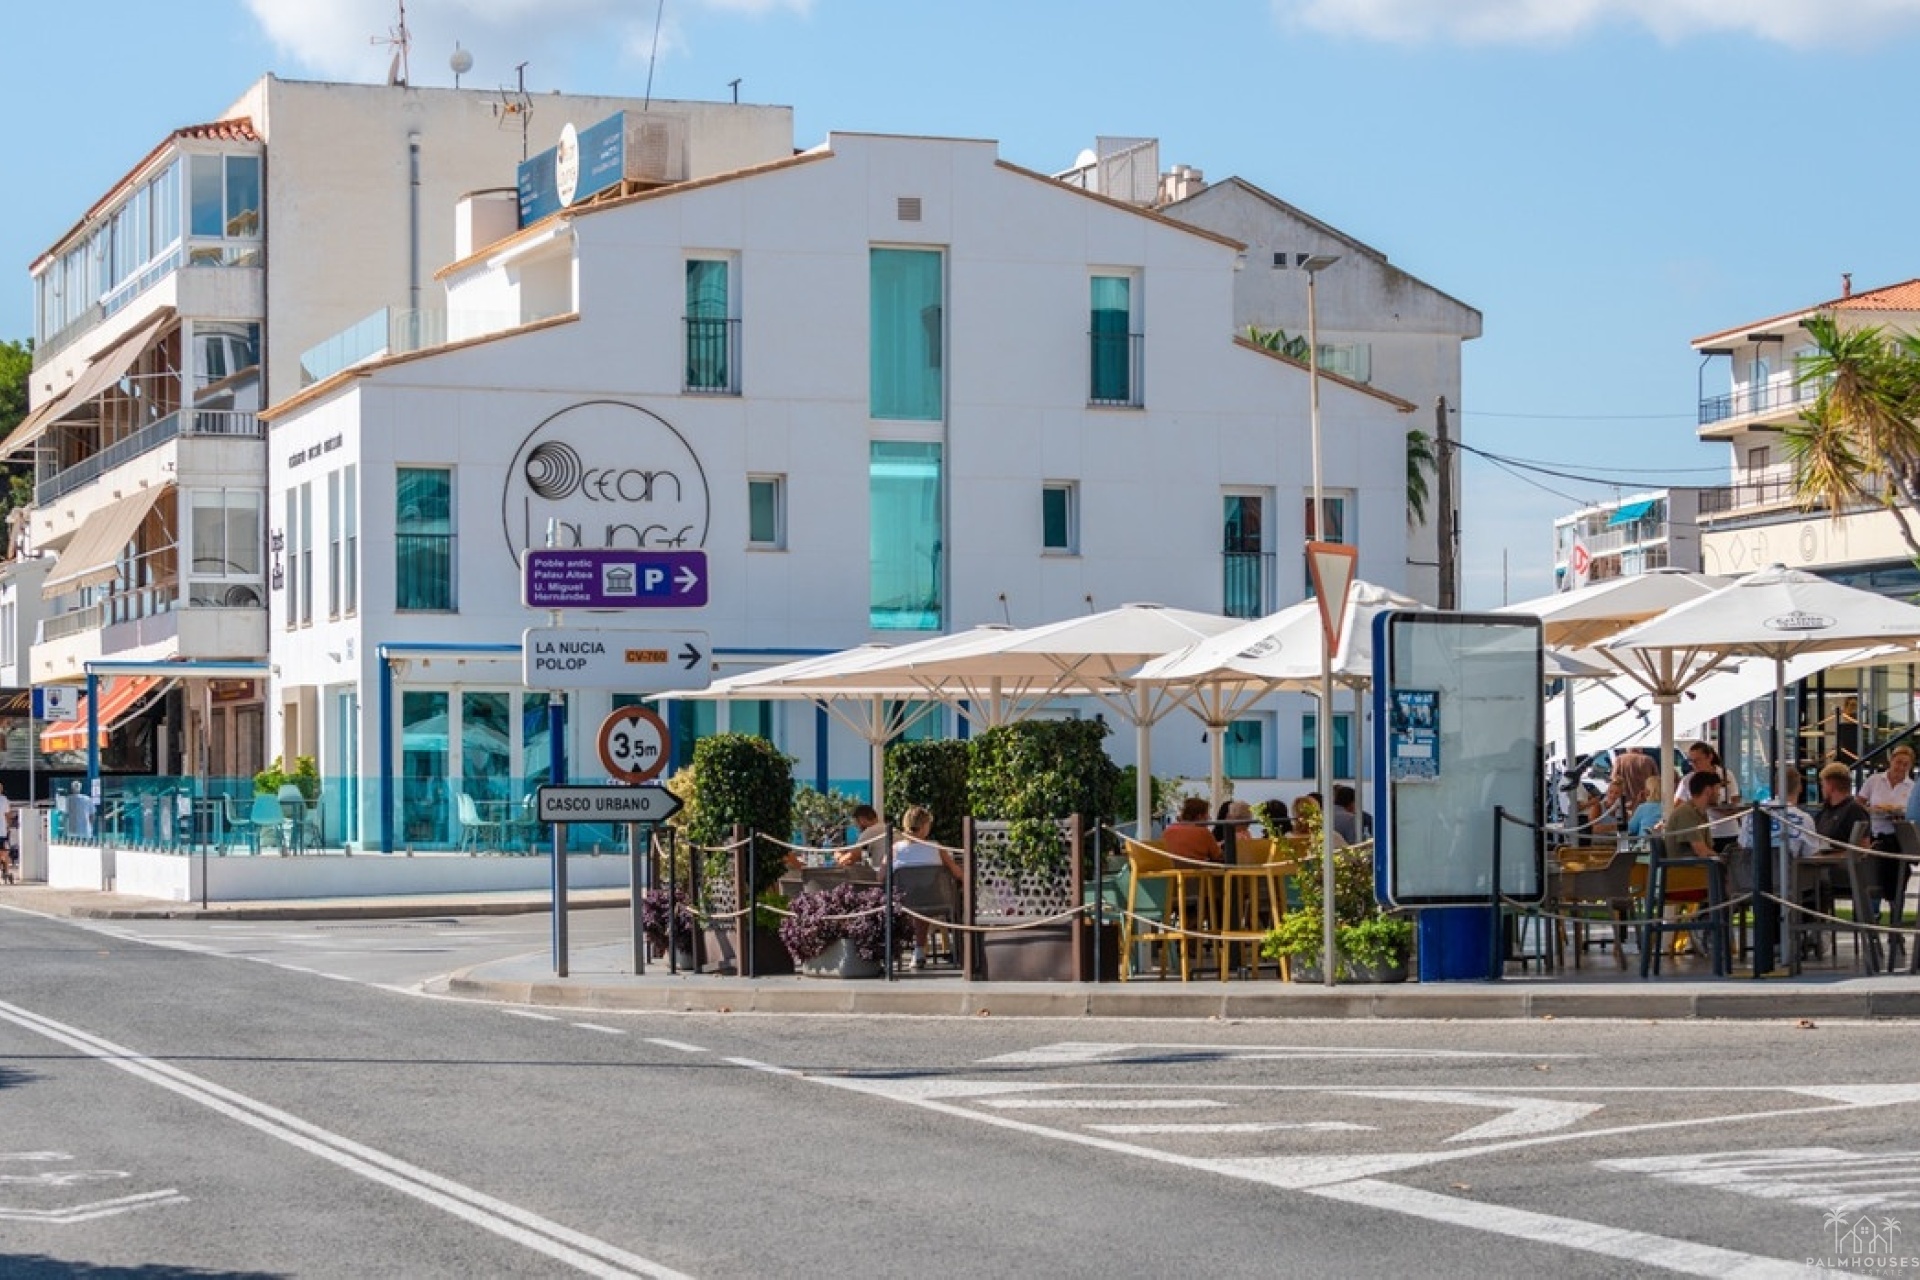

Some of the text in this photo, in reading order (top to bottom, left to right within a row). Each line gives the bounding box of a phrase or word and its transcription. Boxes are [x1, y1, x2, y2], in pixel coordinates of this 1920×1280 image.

[534, 559, 593, 568] Poble antic
[534, 570, 593, 578] Palau Altea
[645, 568, 664, 591] P
[534, 582, 583, 593] U. Miguel
[536, 642, 606, 654] LA NUCIA
[626, 651, 665, 662] CV-760
[536, 658, 587, 670] POLOP
[546, 797, 650, 811] CASCO URBANO
